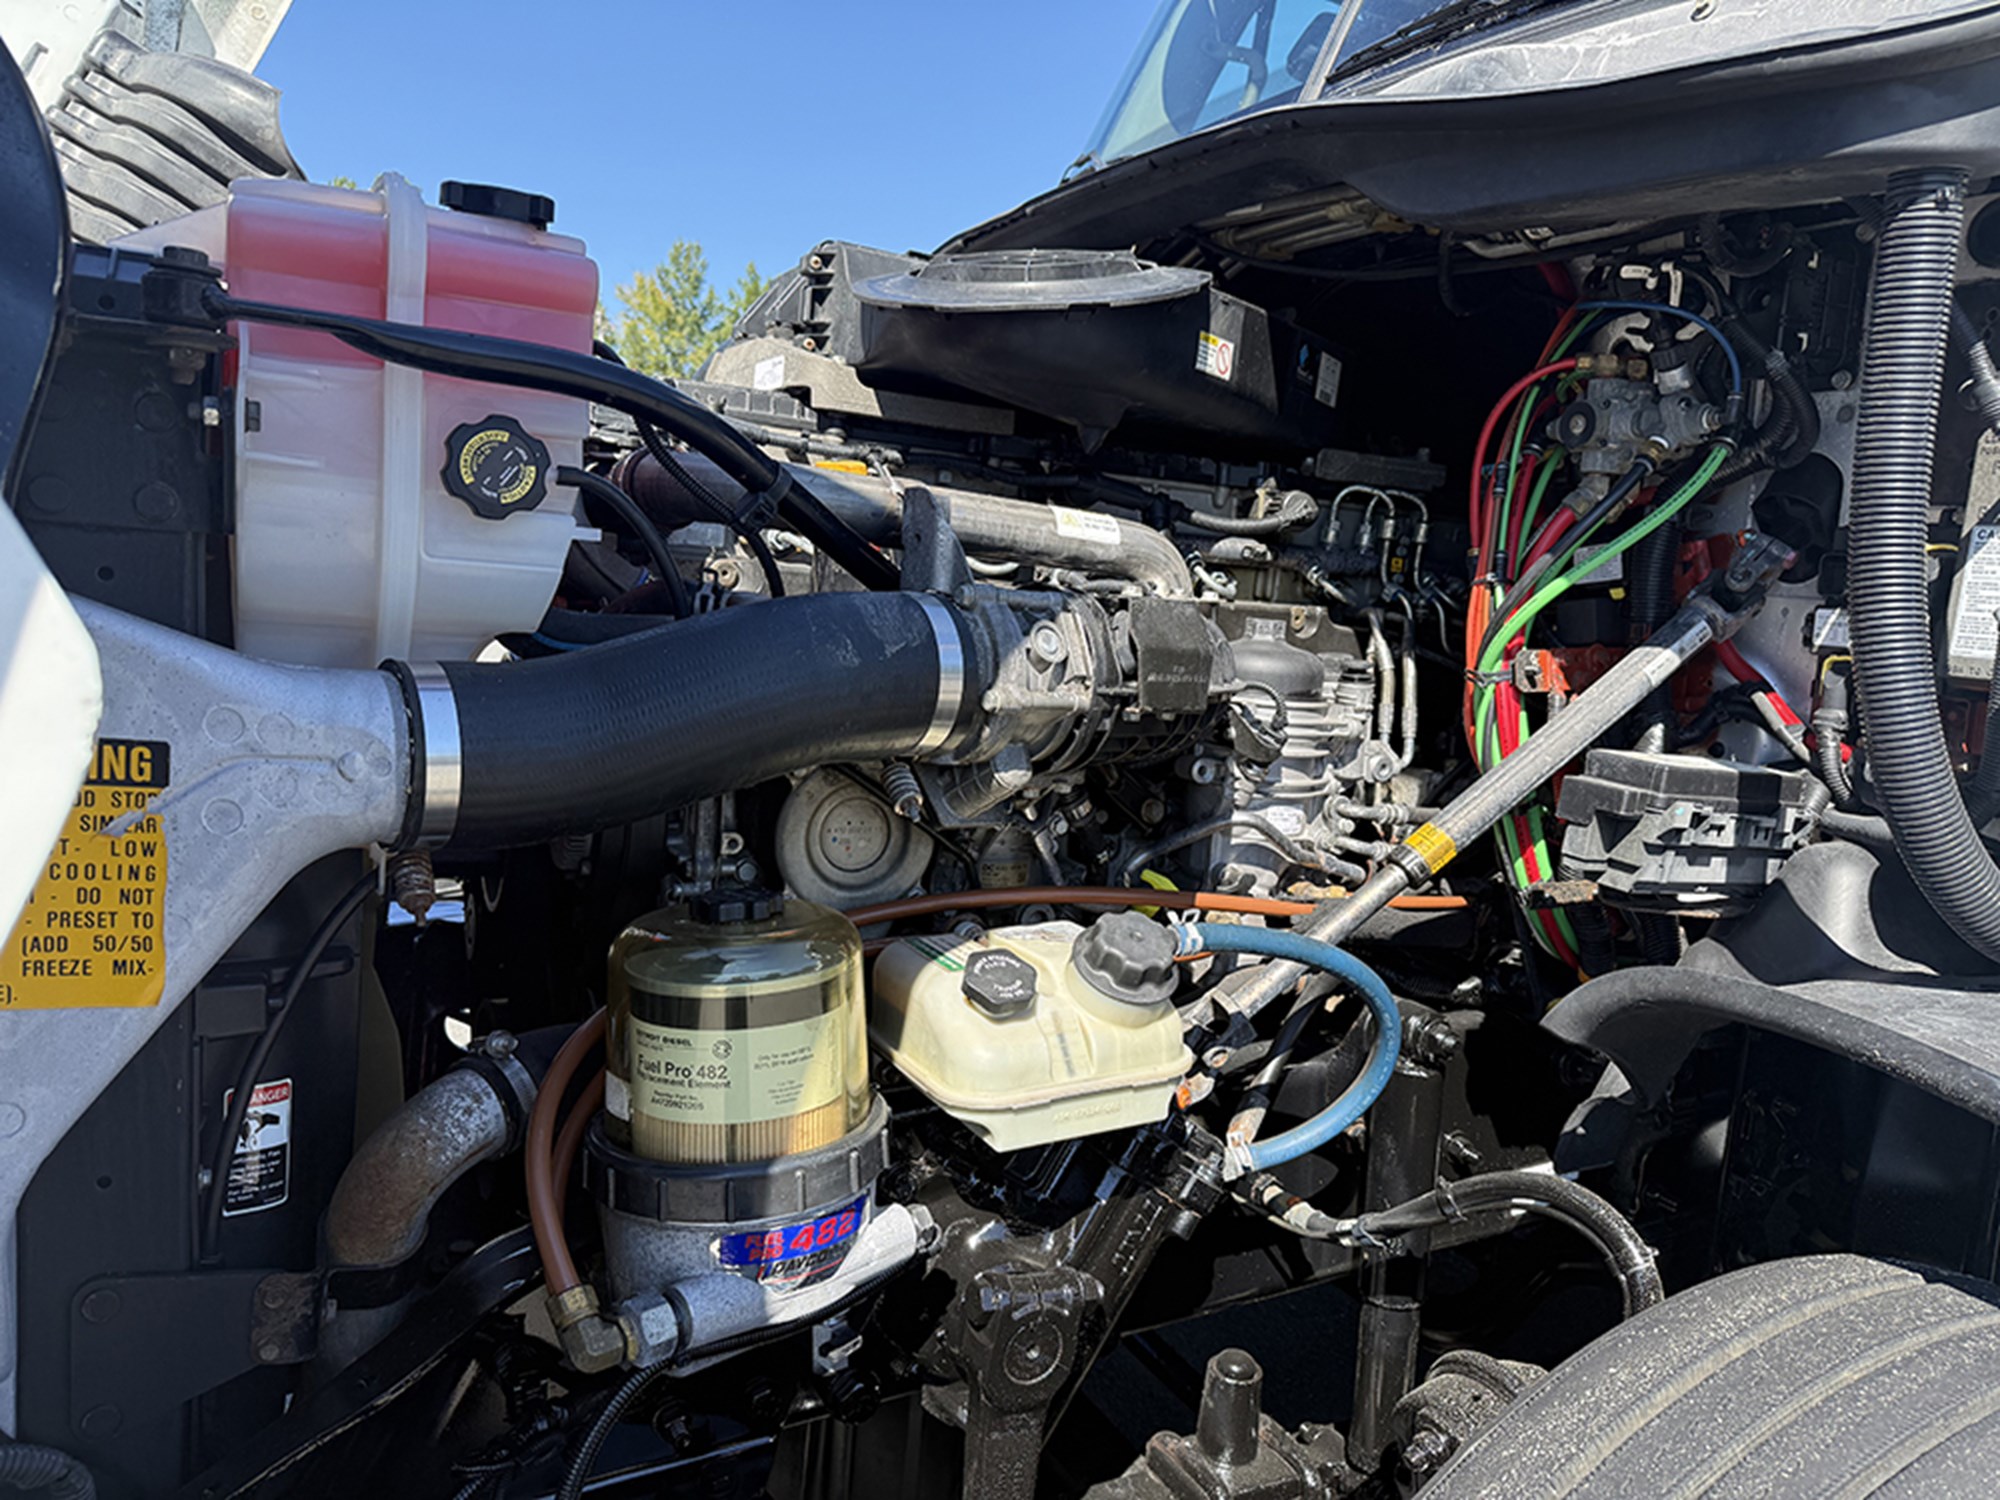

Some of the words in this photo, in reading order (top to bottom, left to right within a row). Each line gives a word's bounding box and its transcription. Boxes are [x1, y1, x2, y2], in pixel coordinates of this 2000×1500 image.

[80, 814, 157, 833] SIMAR
[110, 839, 157, 858] LOW
[49, 862, 156, 882] COOLING
[76, 886, 101, 905] DO
[119, 887, 154, 905] NOT
[47, 911, 118, 928] PRESET
[131, 911, 154, 929] TO
[22, 935, 69, 957] (ADD
[93, 934, 153, 953] 50/50
[22, 959, 93, 977] FREEZE
[112, 959, 154, 976] MIX-
[638, 1054, 661, 1074] Fuel
[665, 1062, 692, 1078] Pro
[696, 1065, 728, 1080] 482
[249, 1087, 287, 1105] ANGER
[745, 1230, 785, 1249] FUEL
[790, 1208, 855, 1251] 482
[749, 1245, 784, 1262] PRO
